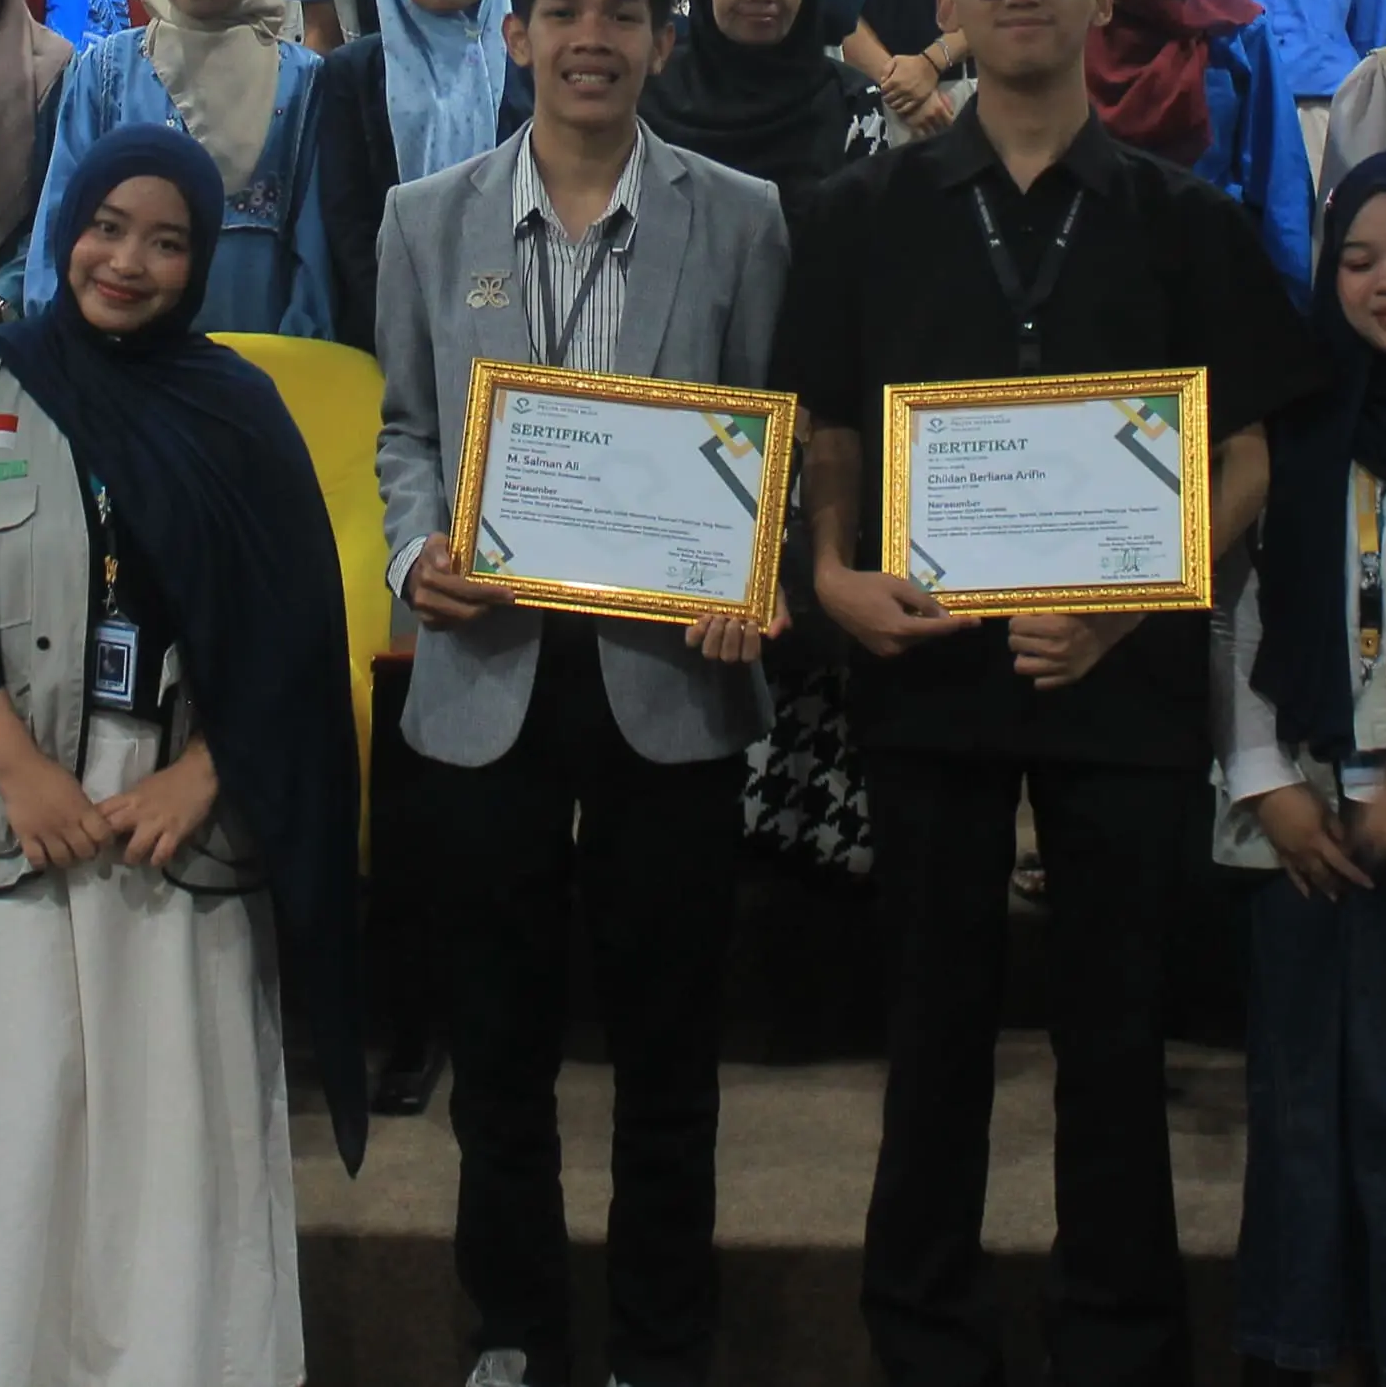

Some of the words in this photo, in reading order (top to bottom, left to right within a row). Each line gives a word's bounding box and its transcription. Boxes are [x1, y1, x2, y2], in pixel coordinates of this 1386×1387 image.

[511, 422, 612, 446] SERTIFIKAT
[928, 438, 1028, 455] SERTIFIKAT
[507, 453, 521, 464] M.
[523, 454, 562, 471] Salman
[564, 460, 580, 471] Ali
[969, 471, 1013, 482] Berliana
[1016, 469, 1046, 480] Arifin
[504, 481, 558, 495] Narasumber
[928, 498, 981, 509] Narasumber
